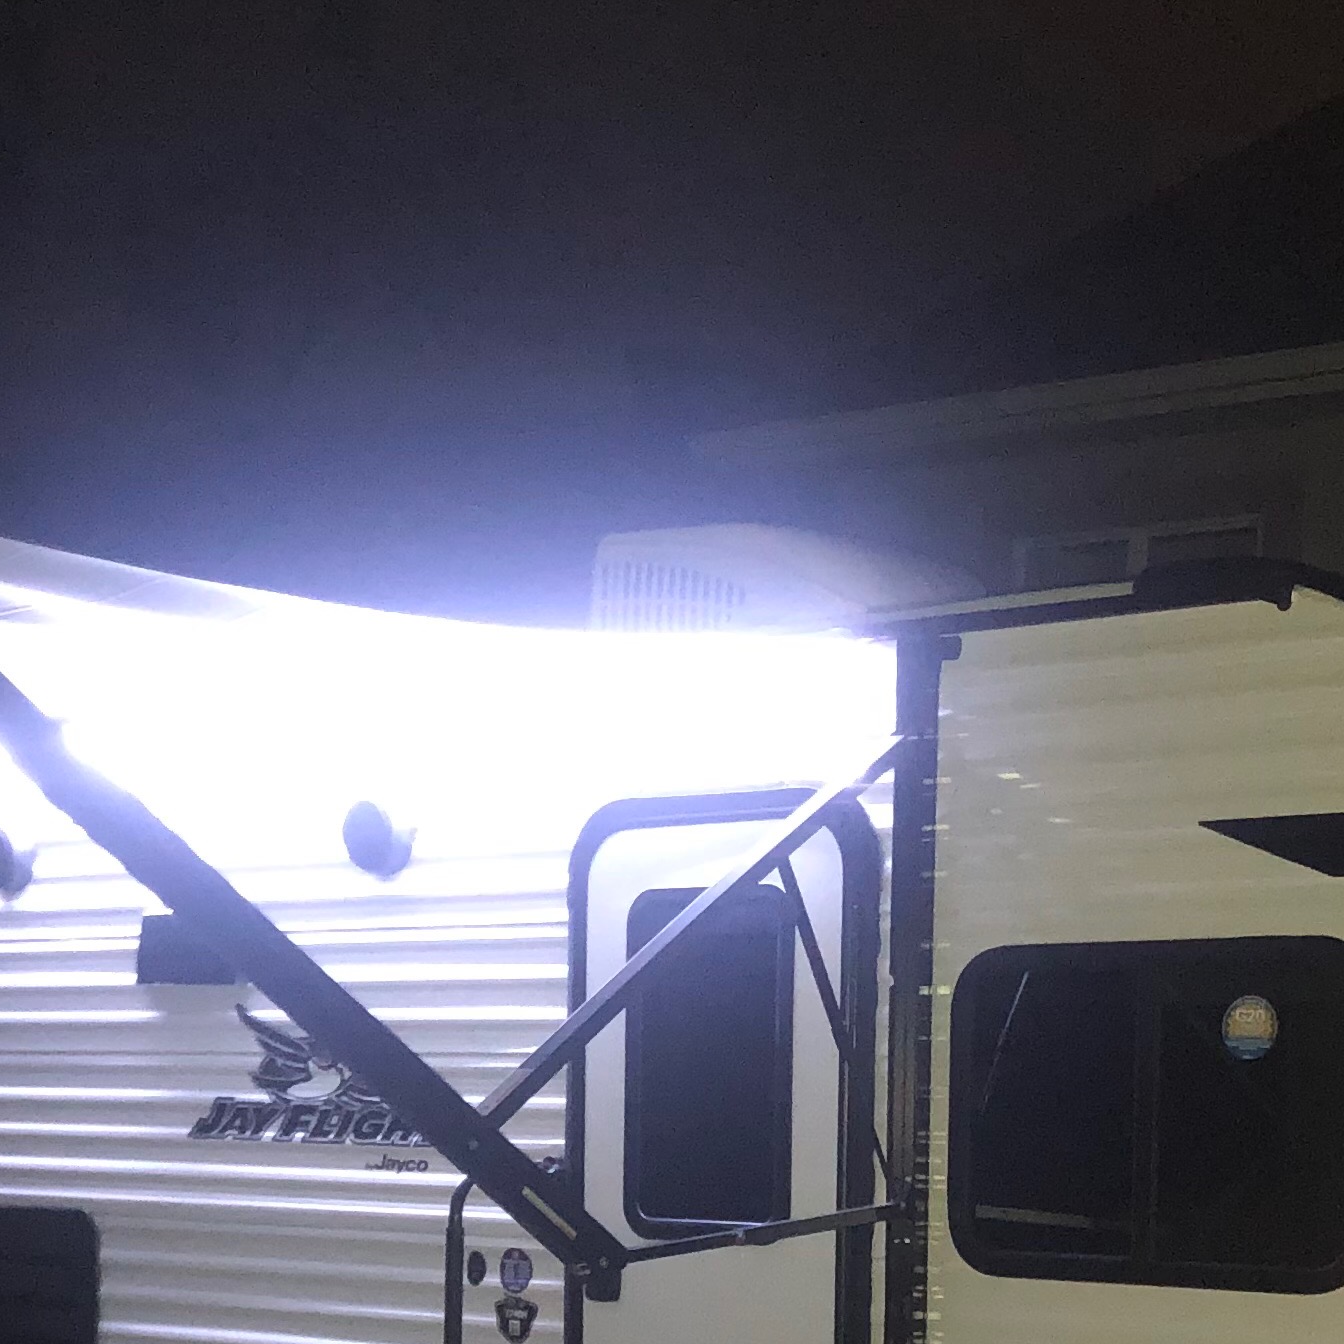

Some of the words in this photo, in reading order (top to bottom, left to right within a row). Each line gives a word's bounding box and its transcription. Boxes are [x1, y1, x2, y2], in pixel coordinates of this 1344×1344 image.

[187, 1096, 285, 1142] JAY
[271, 1099, 433, 1148] FLIGH
[375, 1153, 429, 1174] Jayco
